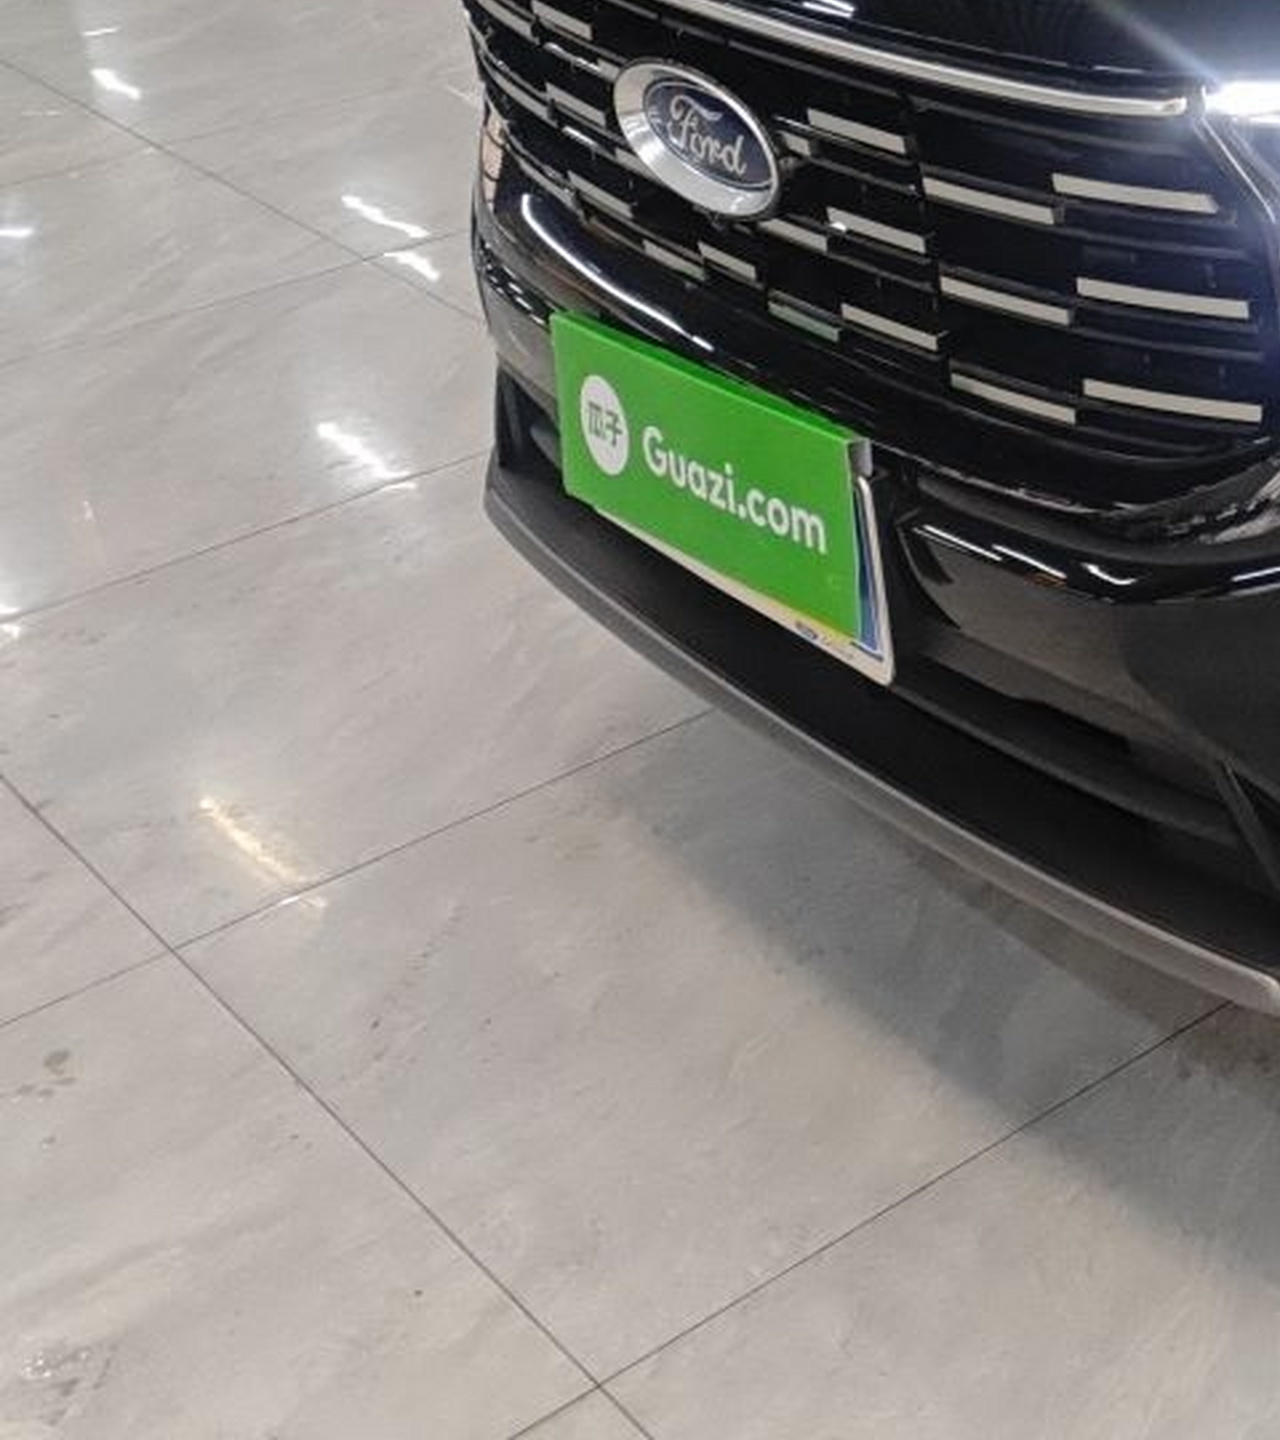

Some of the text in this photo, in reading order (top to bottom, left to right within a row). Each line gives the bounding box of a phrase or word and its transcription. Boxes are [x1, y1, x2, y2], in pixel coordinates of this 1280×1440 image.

[669, 95, 750, 175] Ford
[587, 401, 623, 447] 瓜子
[643, 426, 827, 554] Guazi.com
